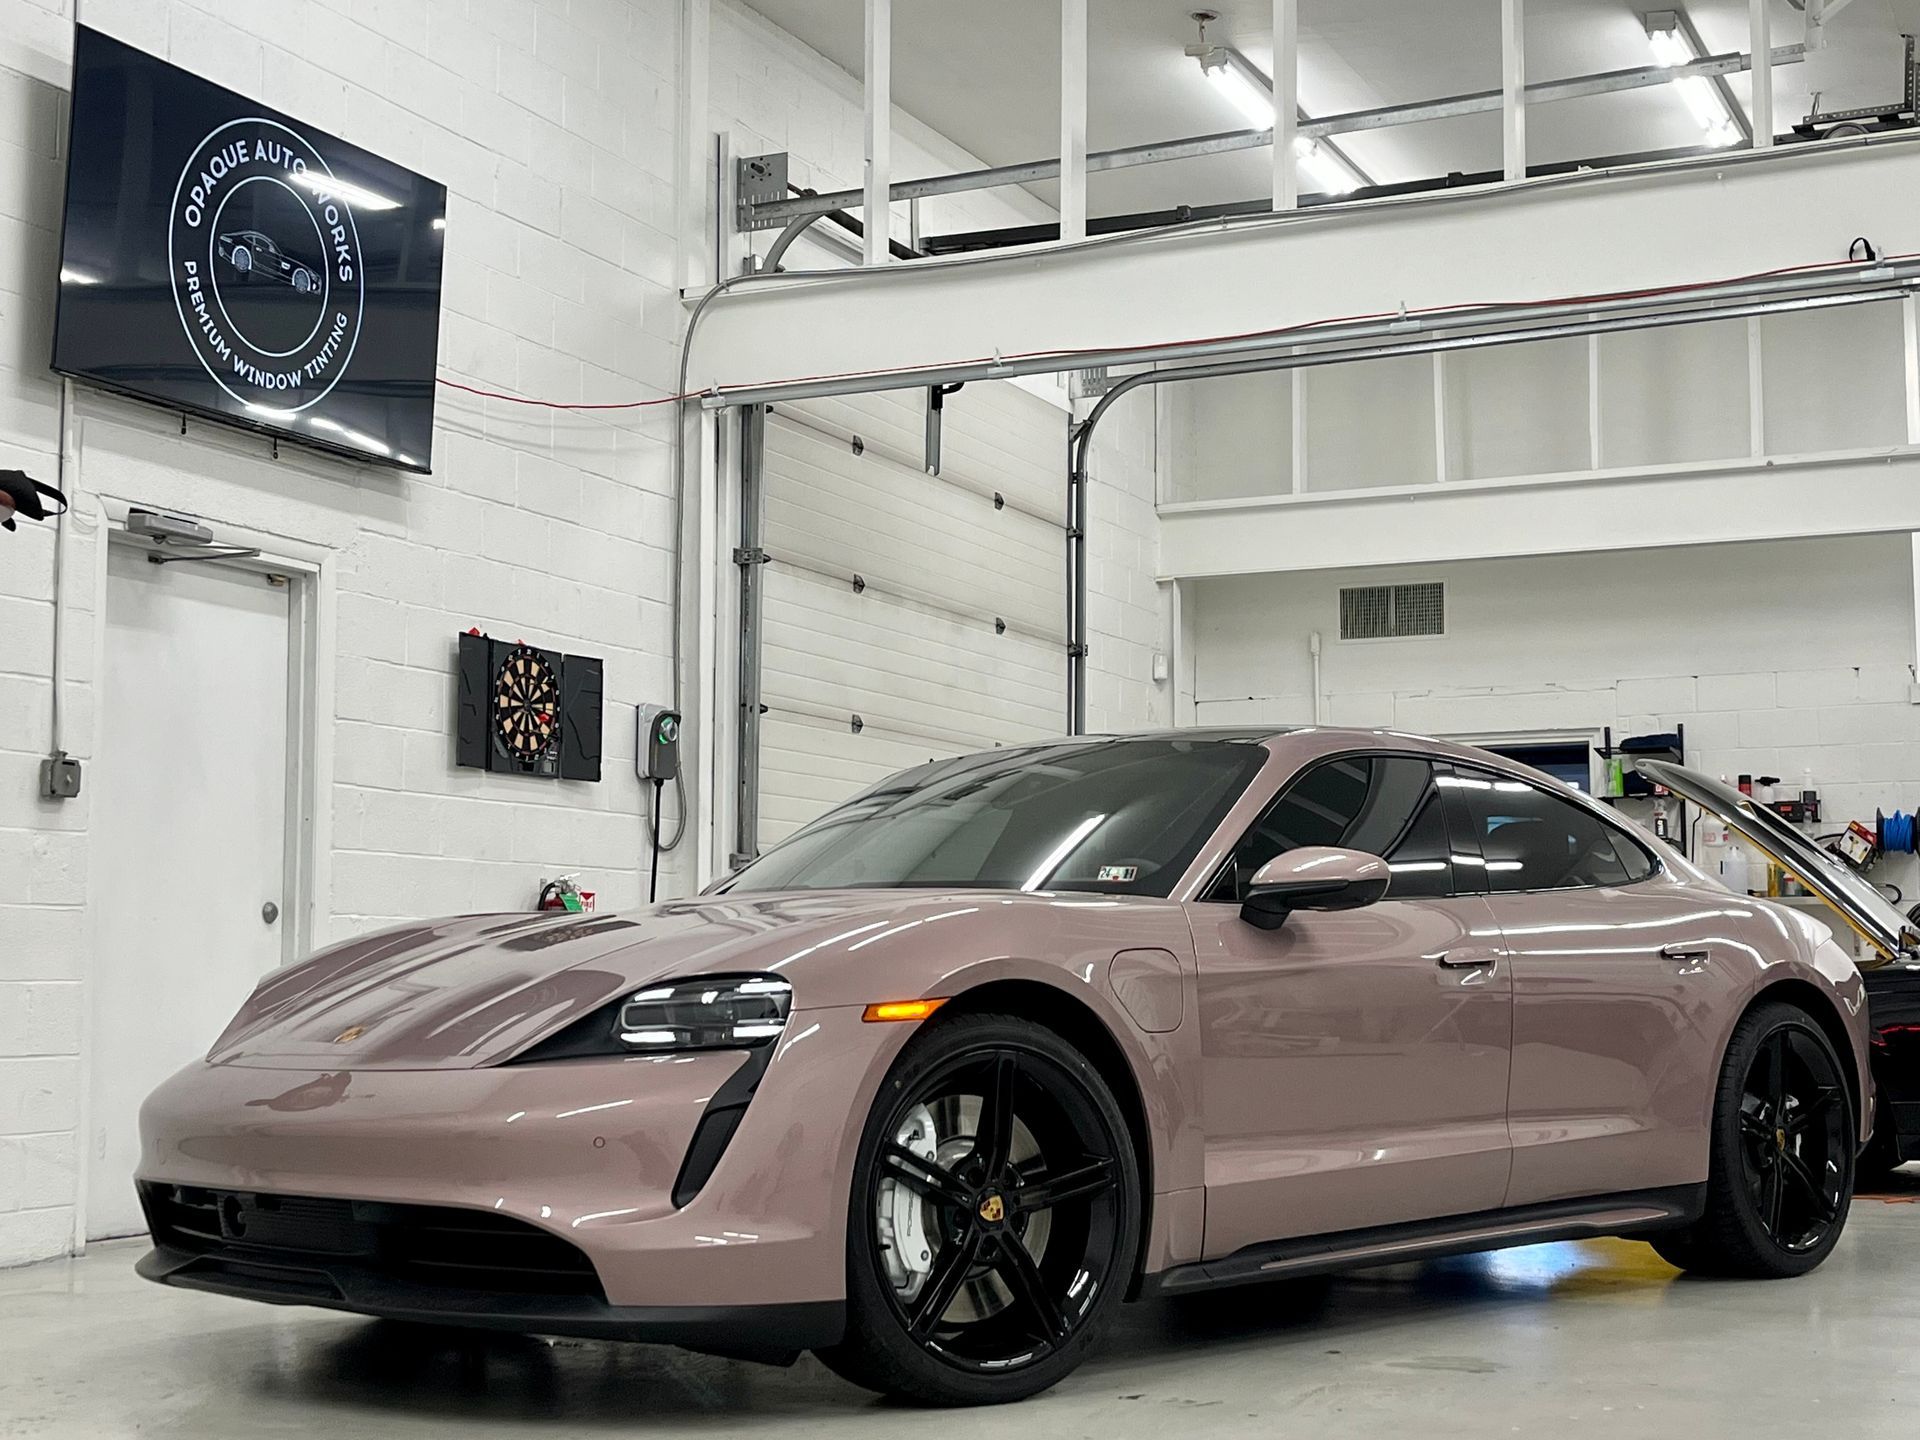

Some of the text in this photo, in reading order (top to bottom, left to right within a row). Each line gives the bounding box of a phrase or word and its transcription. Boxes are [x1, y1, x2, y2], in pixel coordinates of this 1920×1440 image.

[184, 139, 250, 228] OPAQUE
[255, 139, 307, 176] AUTO
[184, 261, 348, 390] PREMIUM WINDOW TINTING
